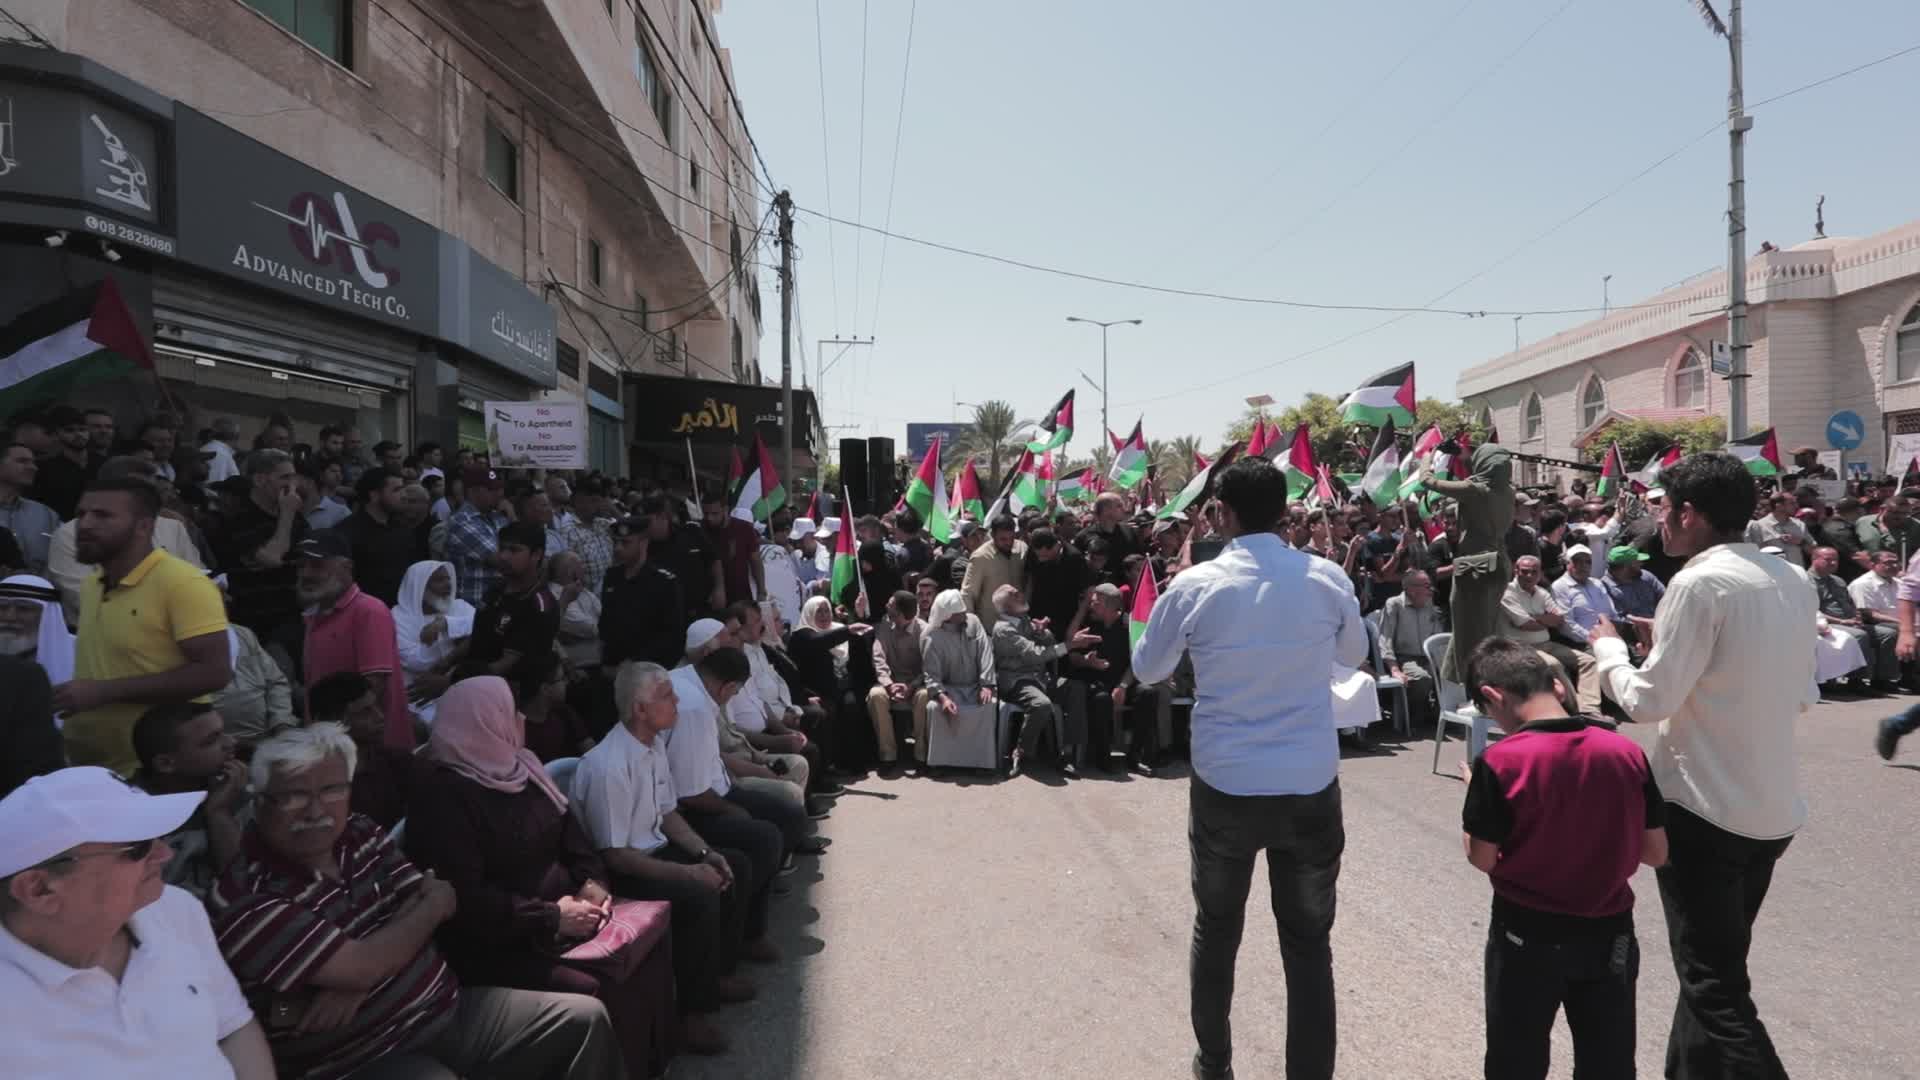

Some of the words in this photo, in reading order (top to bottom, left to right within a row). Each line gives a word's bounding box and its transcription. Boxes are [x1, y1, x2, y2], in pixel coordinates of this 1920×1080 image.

[99, 220, 116, 236] 08
[536, 408, 551, 417] No
[671, 397, 739, 435] الأمير
[513, 420, 526, 429] To
[527, 420, 573, 429] Apartheid
[538, 431, 552, 440] No
[511, 443, 524, 452] To
